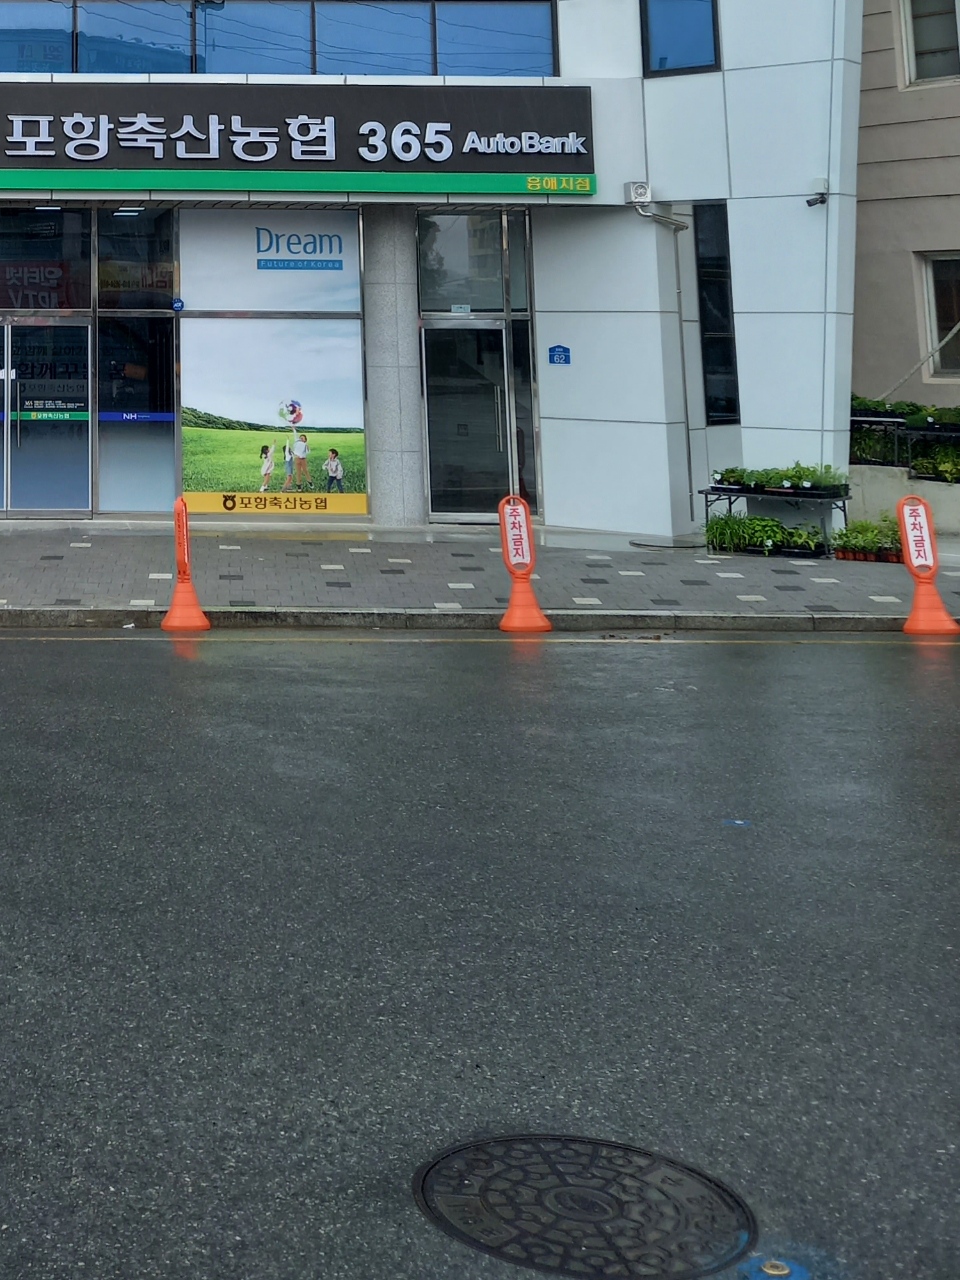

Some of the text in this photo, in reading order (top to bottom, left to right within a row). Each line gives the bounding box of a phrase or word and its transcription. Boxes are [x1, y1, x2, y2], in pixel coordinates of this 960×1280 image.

[4, 112, 336, 162] 포항축산농협
[357, 121, 454, 162] 365
[526, 176, 590, 191] 흥해지점
[255, 226, 343, 254] Dream
[261, 260, 295, 268] Future
[297, 260, 308, 268] of
[554, 355, 566, 363] 62
[123, 412, 137, 420] NH
[239, 496, 328, 510] 포항축산농협
[508, 508, 525, 560] 주차금지
[908, 508, 928, 562] 주차금지
